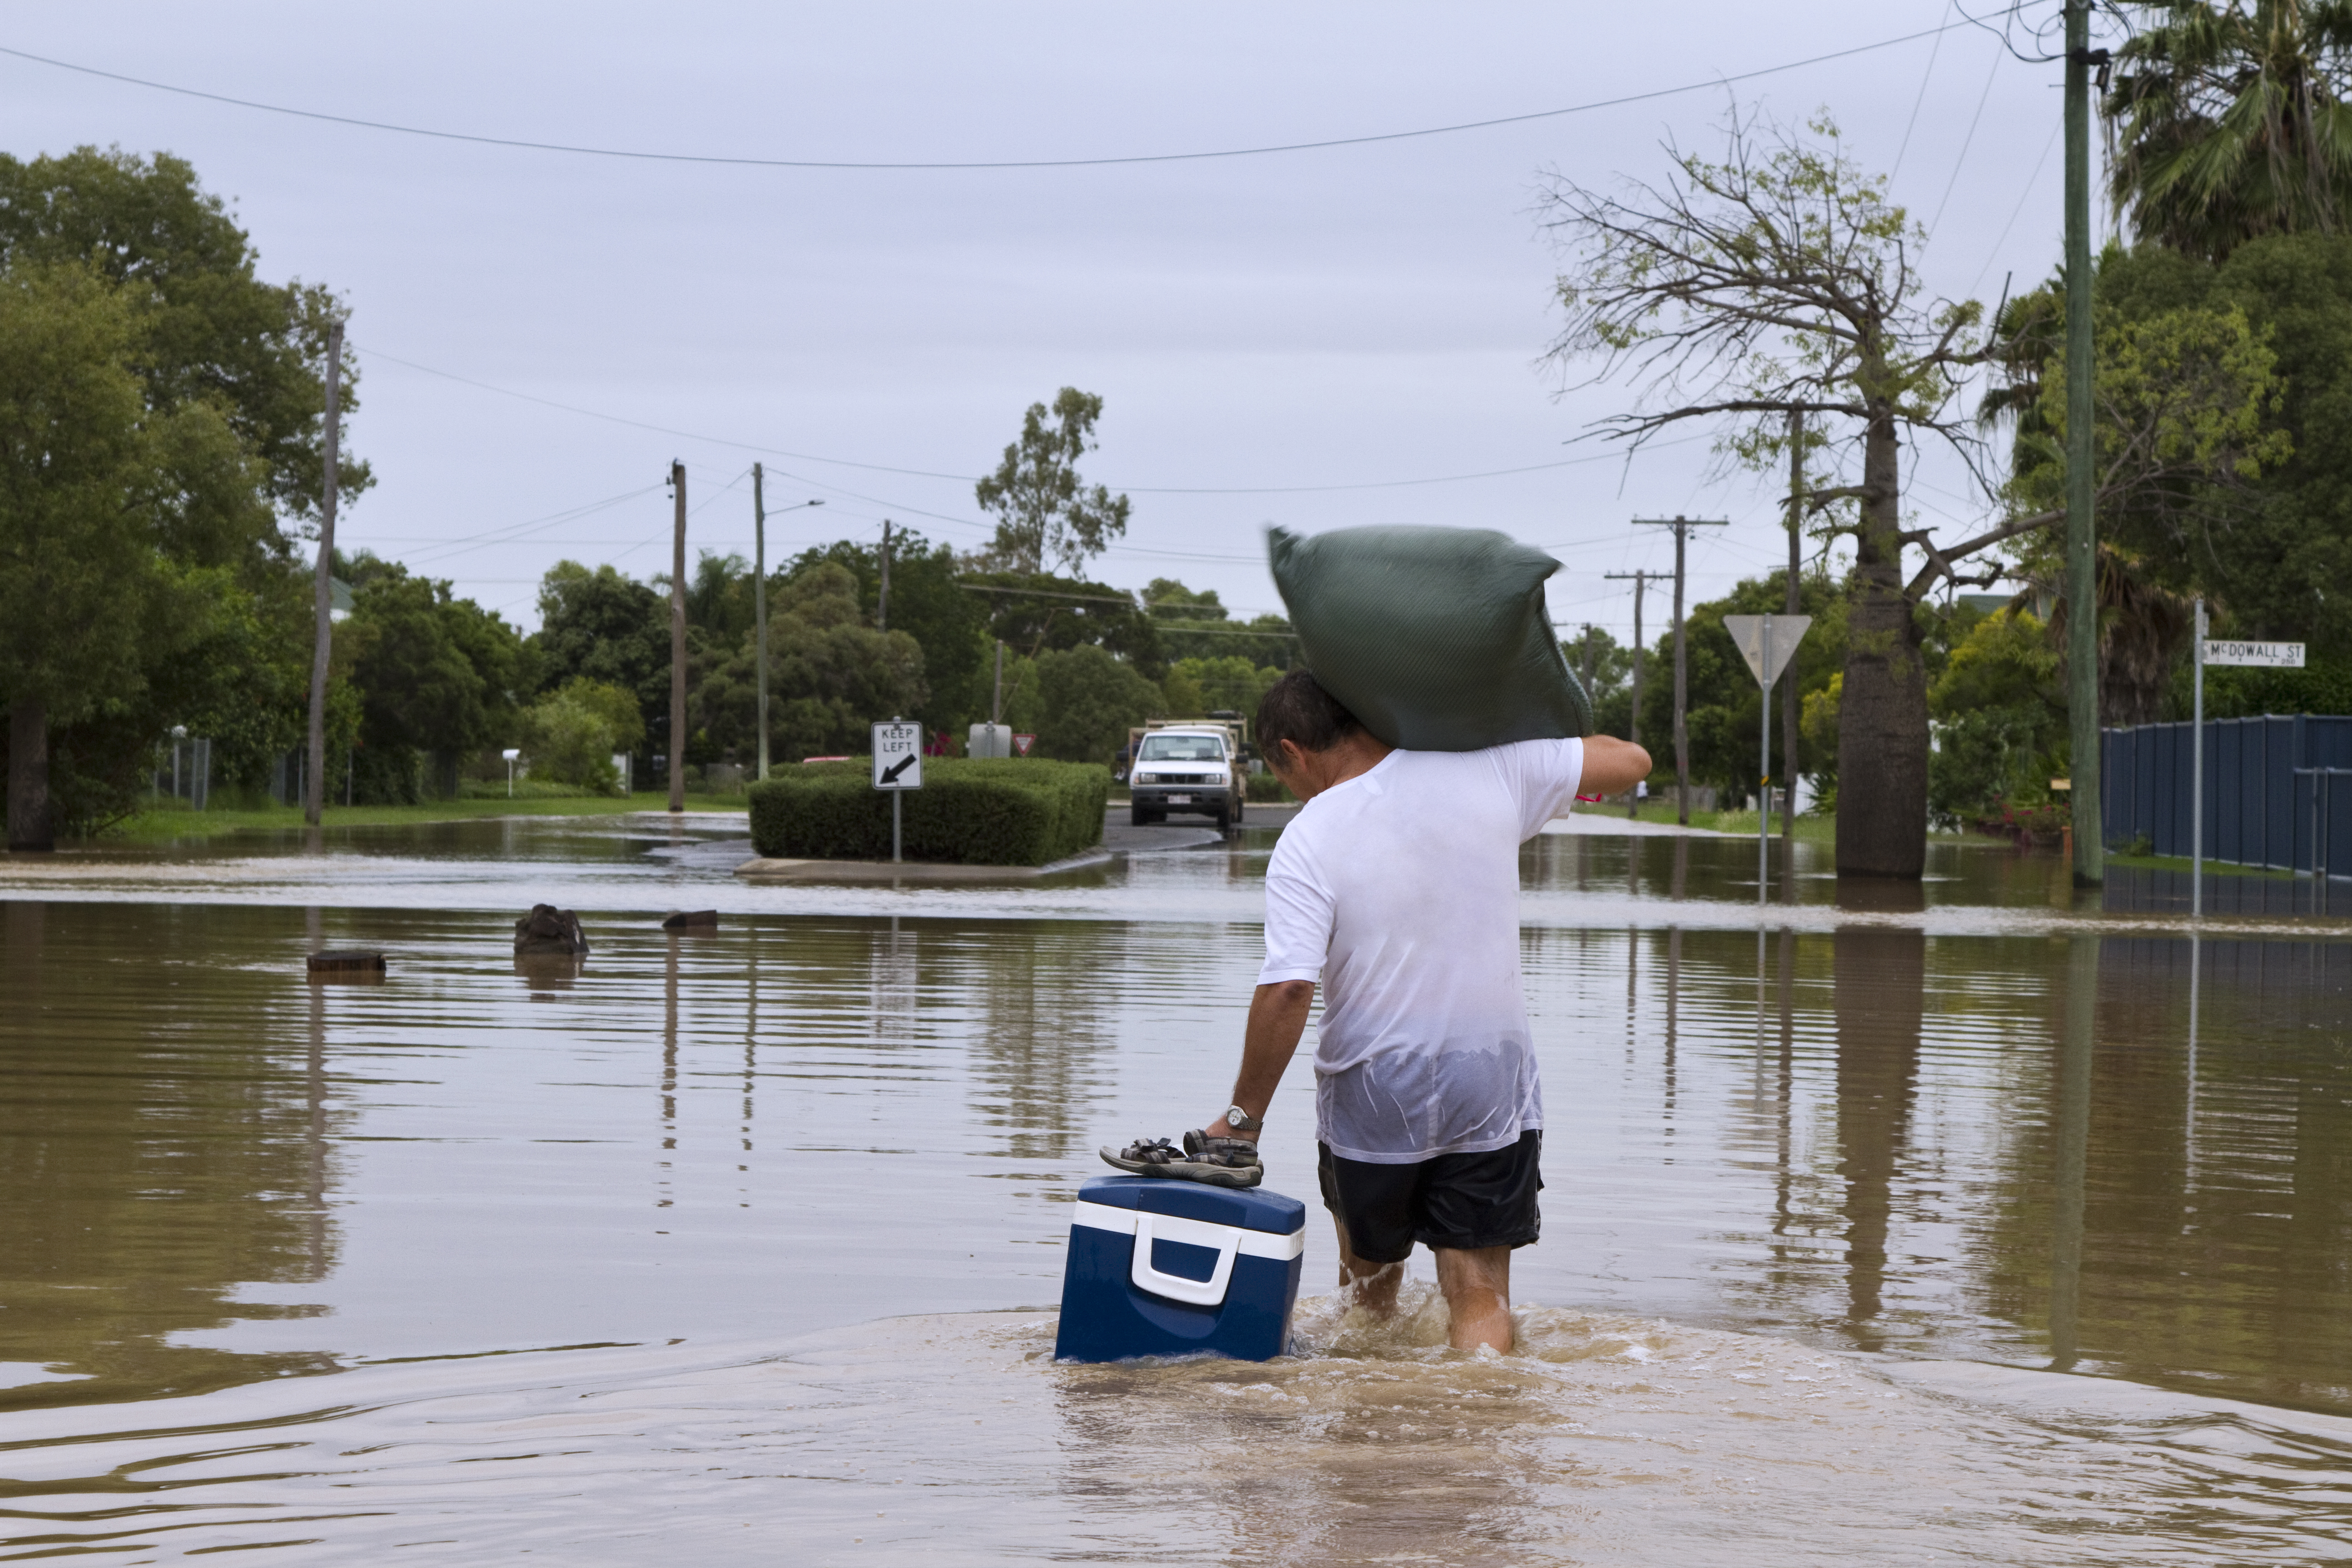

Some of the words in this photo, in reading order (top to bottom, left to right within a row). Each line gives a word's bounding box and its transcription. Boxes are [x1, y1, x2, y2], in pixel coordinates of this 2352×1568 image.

[2288, 645, 2302, 657] ST
[882, 729, 913, 739] KEEP
[883, 741, 911, 752] LEFT
